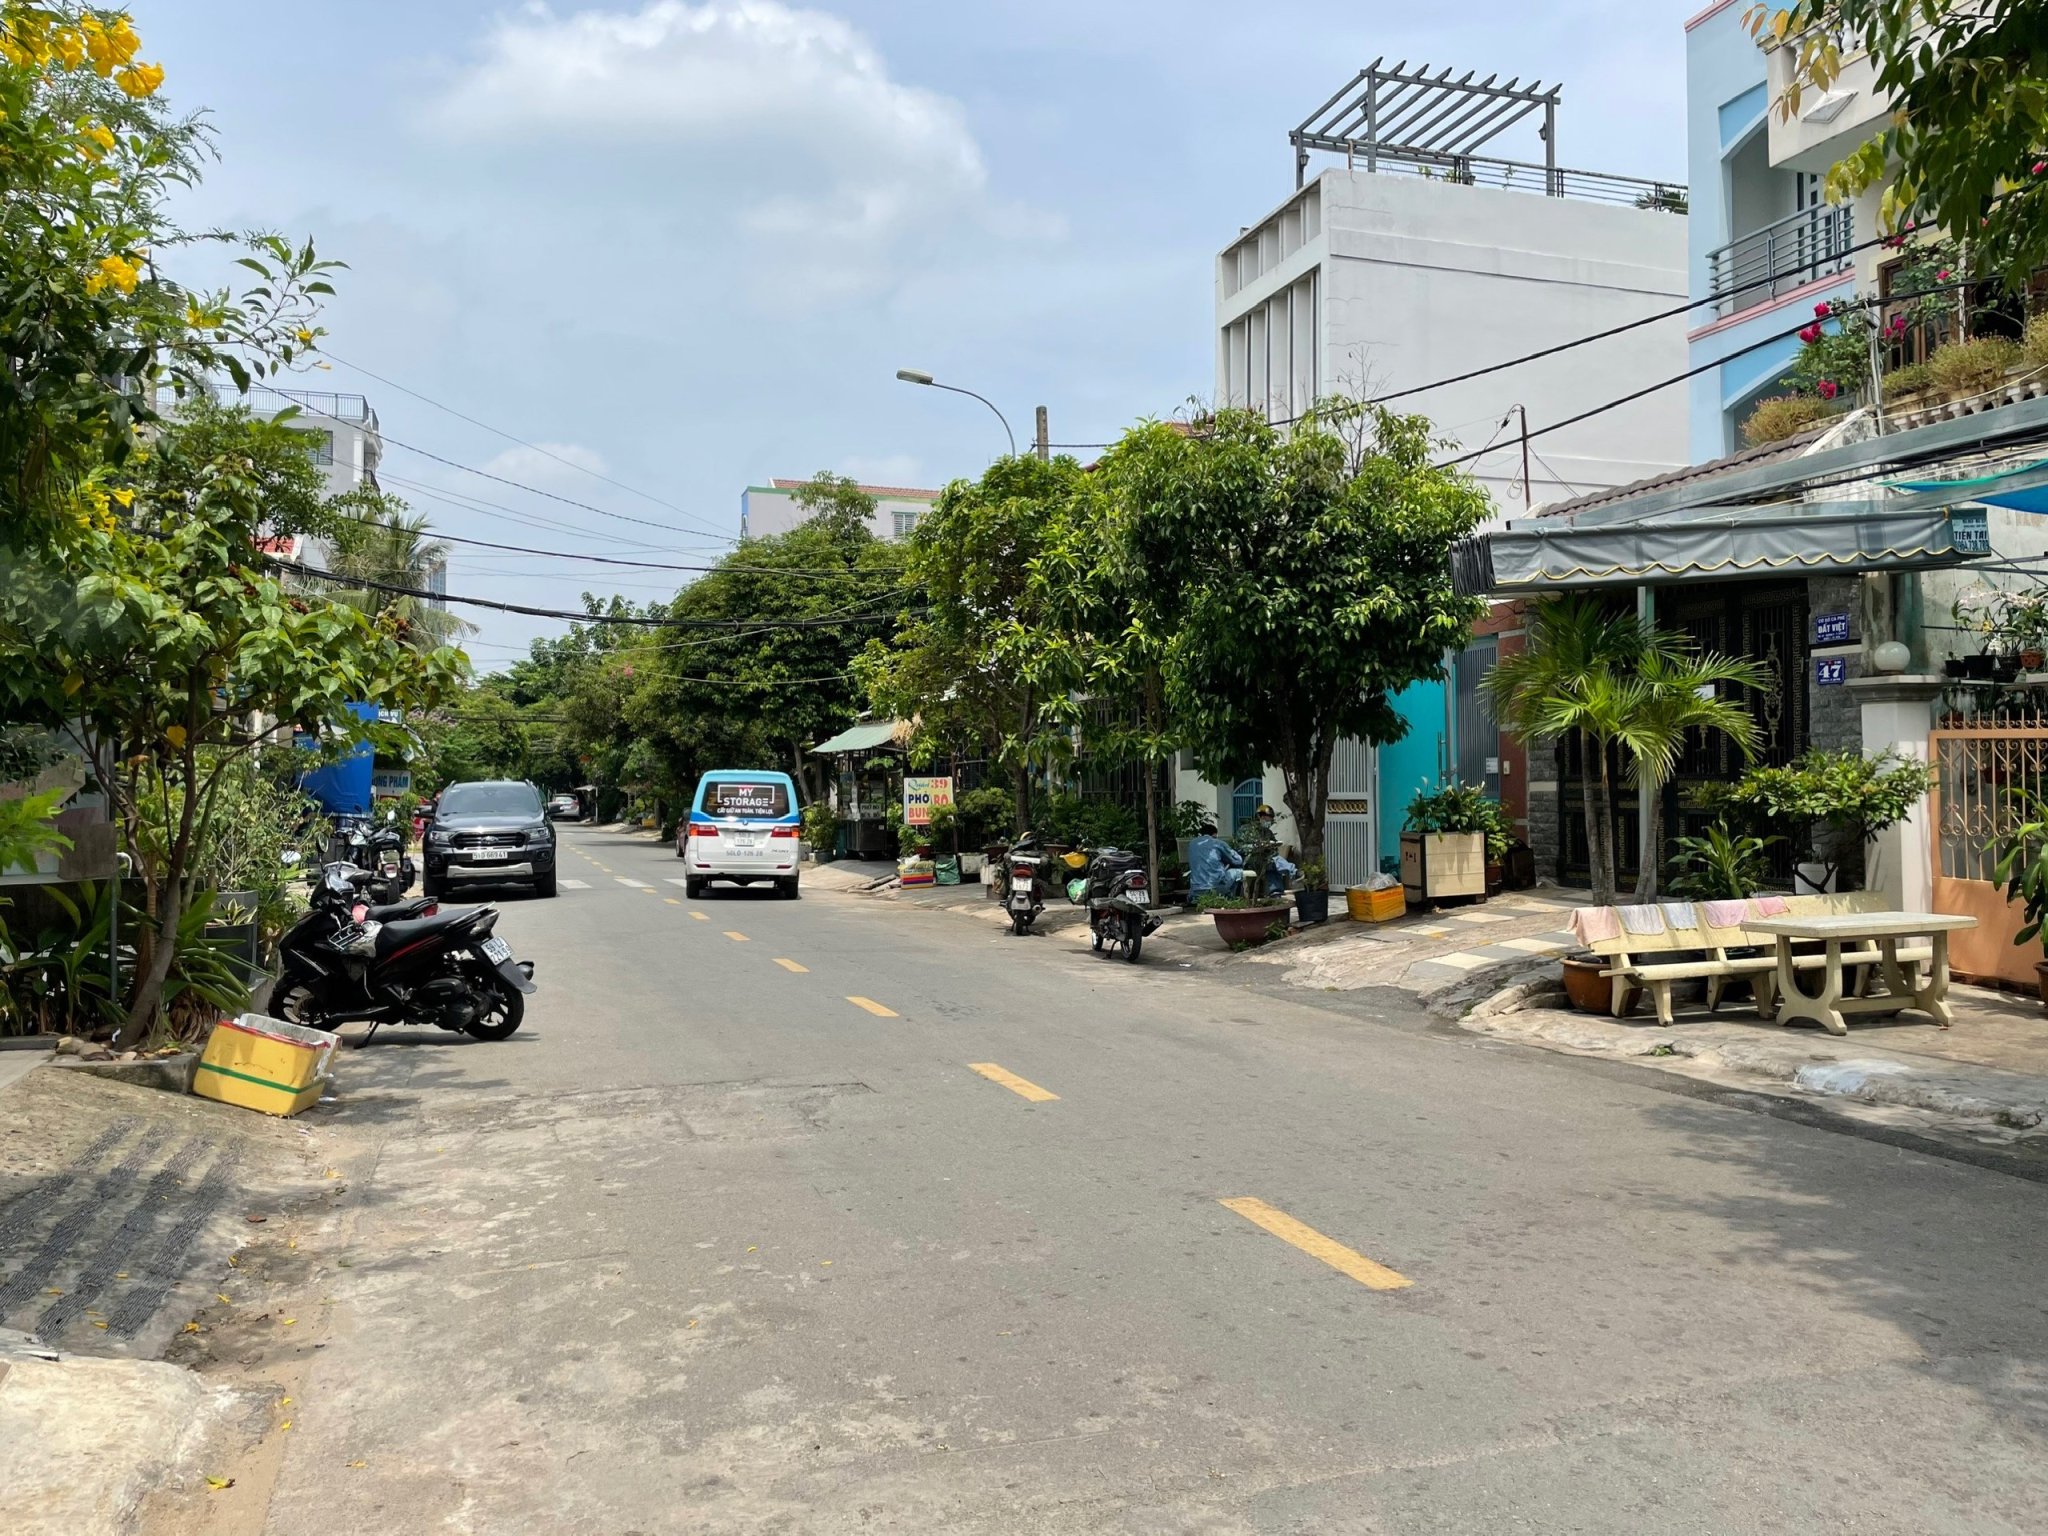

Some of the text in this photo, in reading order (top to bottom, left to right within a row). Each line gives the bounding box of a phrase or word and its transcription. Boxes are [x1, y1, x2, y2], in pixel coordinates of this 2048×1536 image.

[1819, 664, 1841, 678] 47
[931, 779, 948, 789] 39
[739, 788, 753, 796] MY
[723, 797, 768, 806] STORAGE
